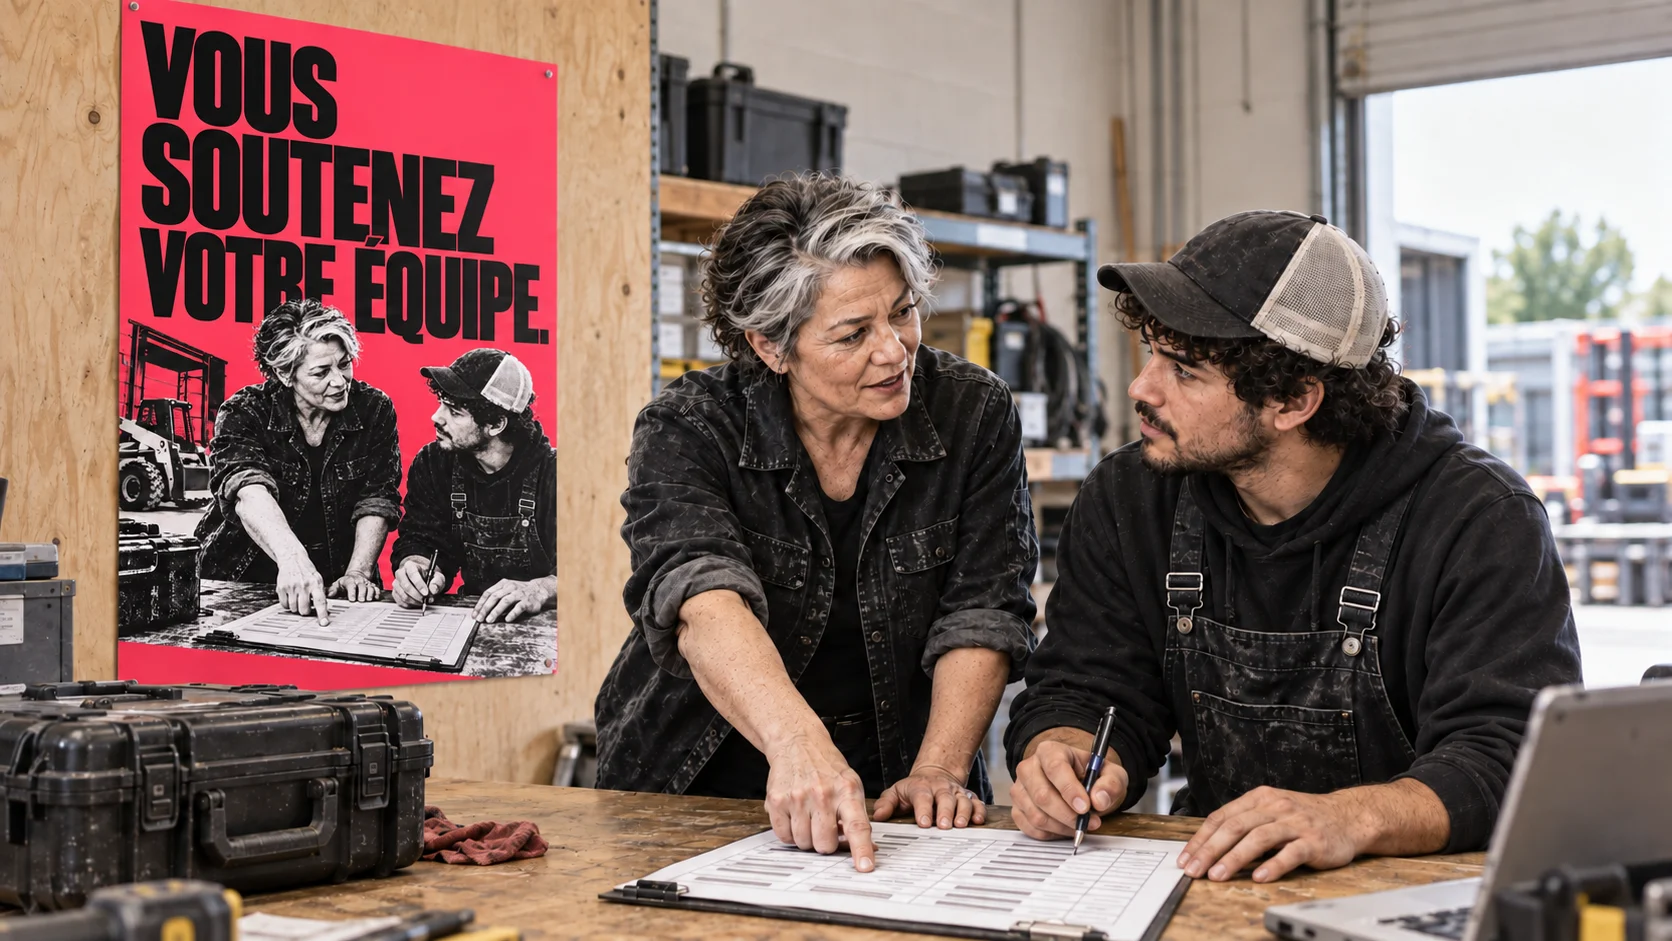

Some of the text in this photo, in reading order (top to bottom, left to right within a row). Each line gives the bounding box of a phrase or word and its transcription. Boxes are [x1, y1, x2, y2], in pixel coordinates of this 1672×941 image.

[140, 20, 337, 139] VOUS
[141, 122, 495, 255] SOUTENEZ
[139, 227, 549, 345] VOTRE ÉQUIPE.
